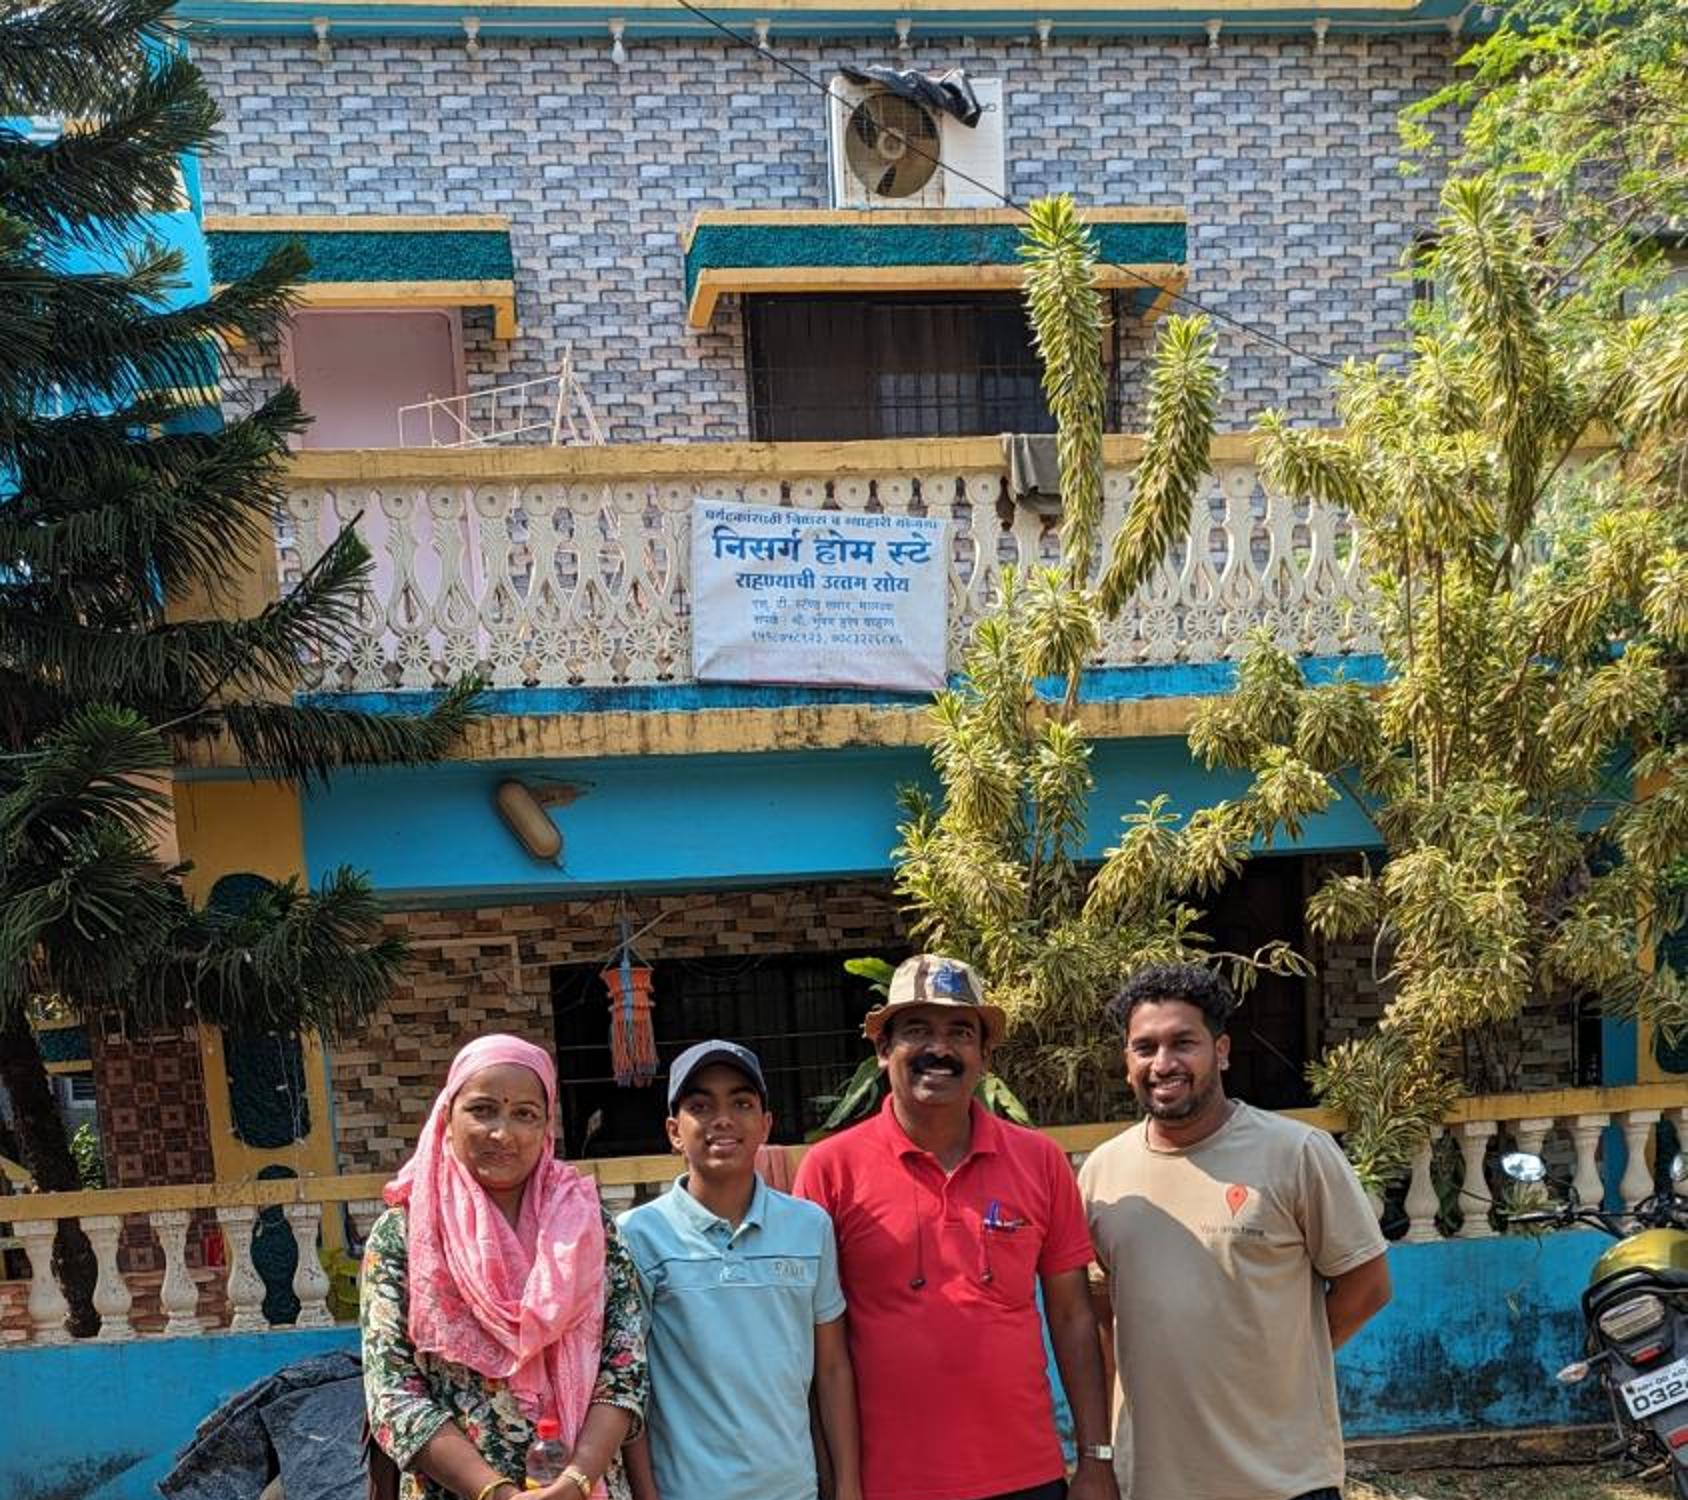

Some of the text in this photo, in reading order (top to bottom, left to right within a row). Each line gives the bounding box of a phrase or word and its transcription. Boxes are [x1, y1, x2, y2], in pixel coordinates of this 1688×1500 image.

[711, 525, 932, 566] निसर्ग होम स्टे
[735, 567, 911, 593] राहण्याची उत्तम सोय
[1633, 1379, 1688, 1412] 032
